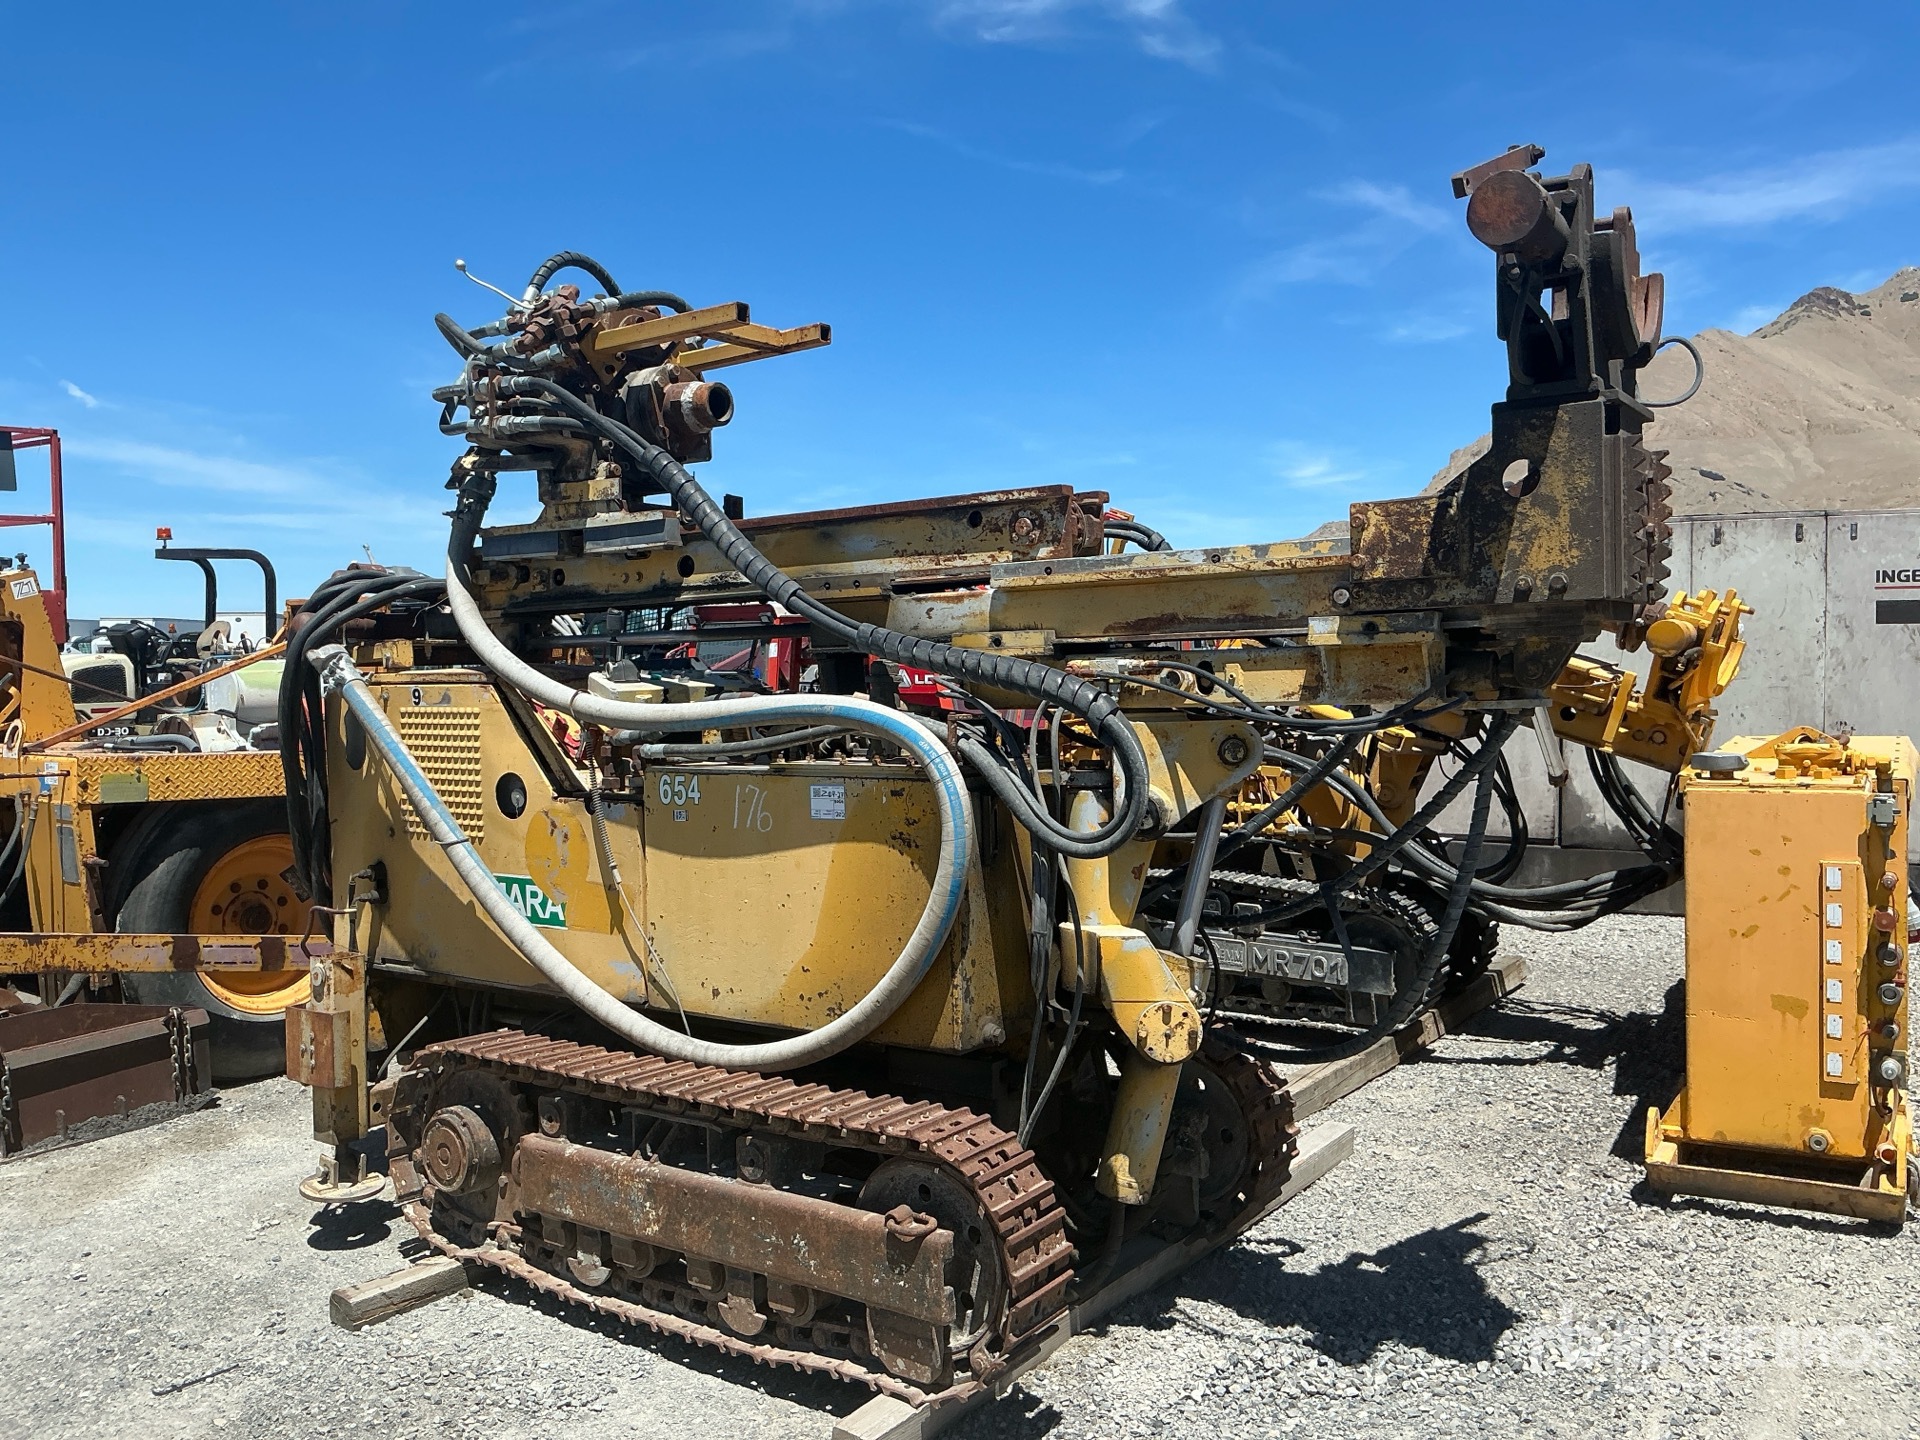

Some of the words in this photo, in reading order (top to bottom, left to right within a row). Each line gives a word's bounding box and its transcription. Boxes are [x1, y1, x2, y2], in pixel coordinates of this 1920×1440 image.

[1876, 569, 1920, 584] INGE
[412, 687, 422, 706] 9
[659, 774, 701, 806] 654
[734, 784, 773, 832] 176
[499, 882, 565, 921] ARA
